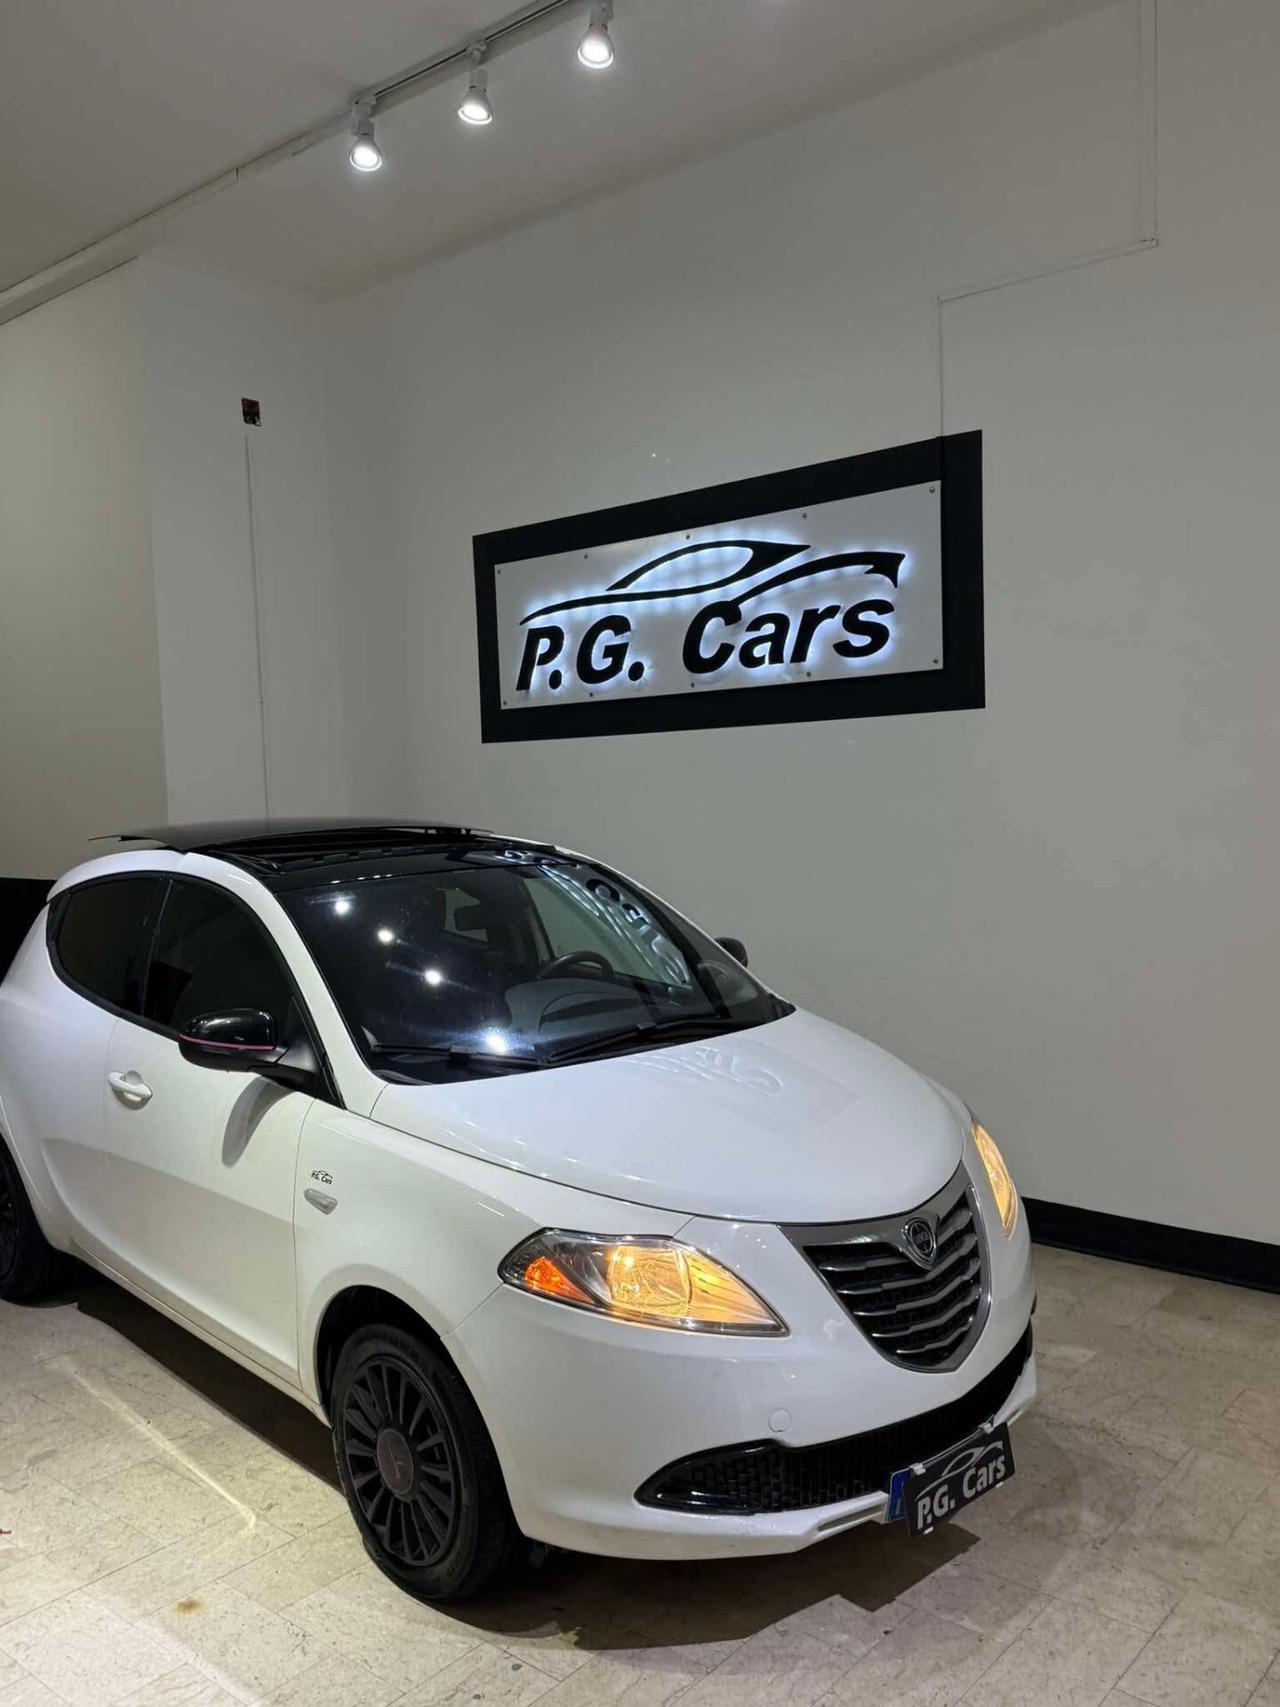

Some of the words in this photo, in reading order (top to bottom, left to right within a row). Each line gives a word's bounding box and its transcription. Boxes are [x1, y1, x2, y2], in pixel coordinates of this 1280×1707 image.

[516, 614, 645, 691] P.G.
[682, 599, 895, 674] Cars
[917, 1484, 955, 1530] P.G.
[963, 1455, 1005, 1499] Cars
